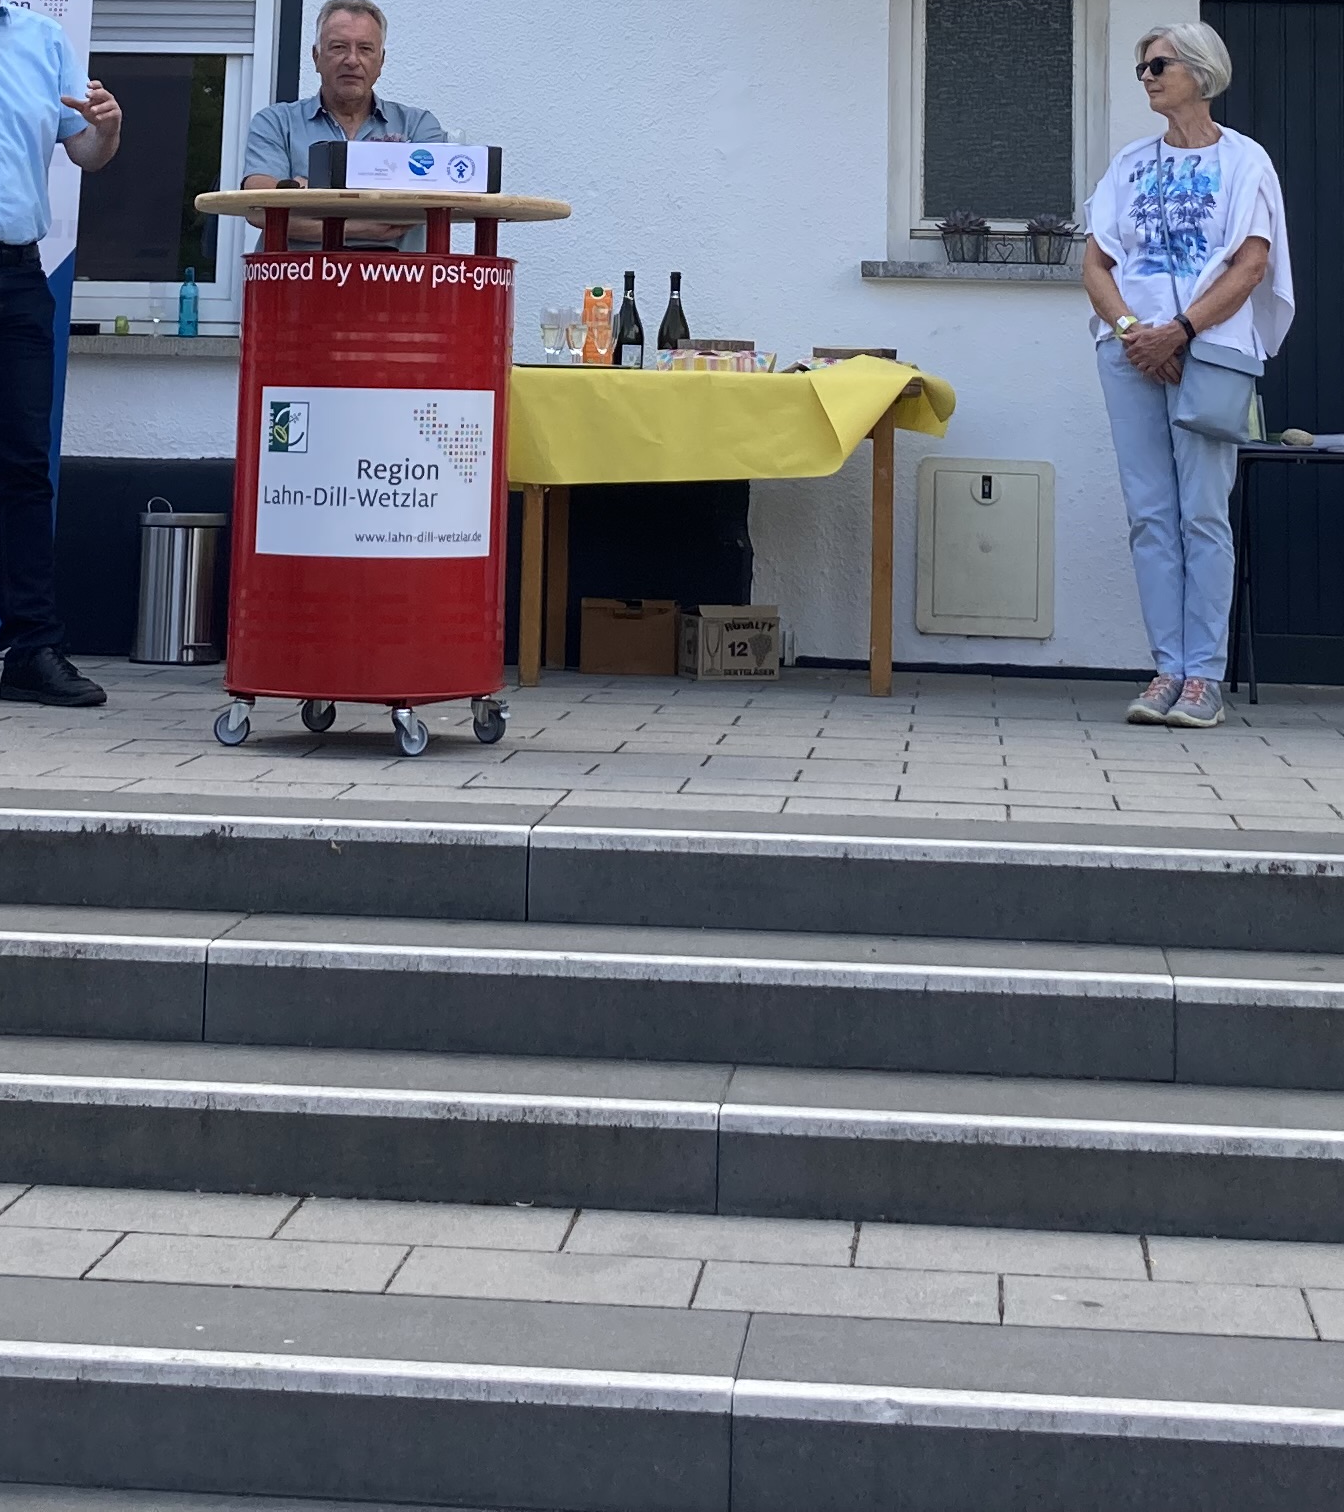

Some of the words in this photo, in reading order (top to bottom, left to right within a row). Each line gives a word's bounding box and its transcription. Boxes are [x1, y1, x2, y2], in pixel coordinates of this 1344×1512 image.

[322, 256, 352, 287] by
[359, 263, 425, 283] www
[357, 457, 439, 486] Region
[264, 485, 439, 508] Lahn-Dill-Wetzlar
[354, 530, 482, 543] www.lahn-dill-wetzlar.de
[727, 641, 749, 657] 12
